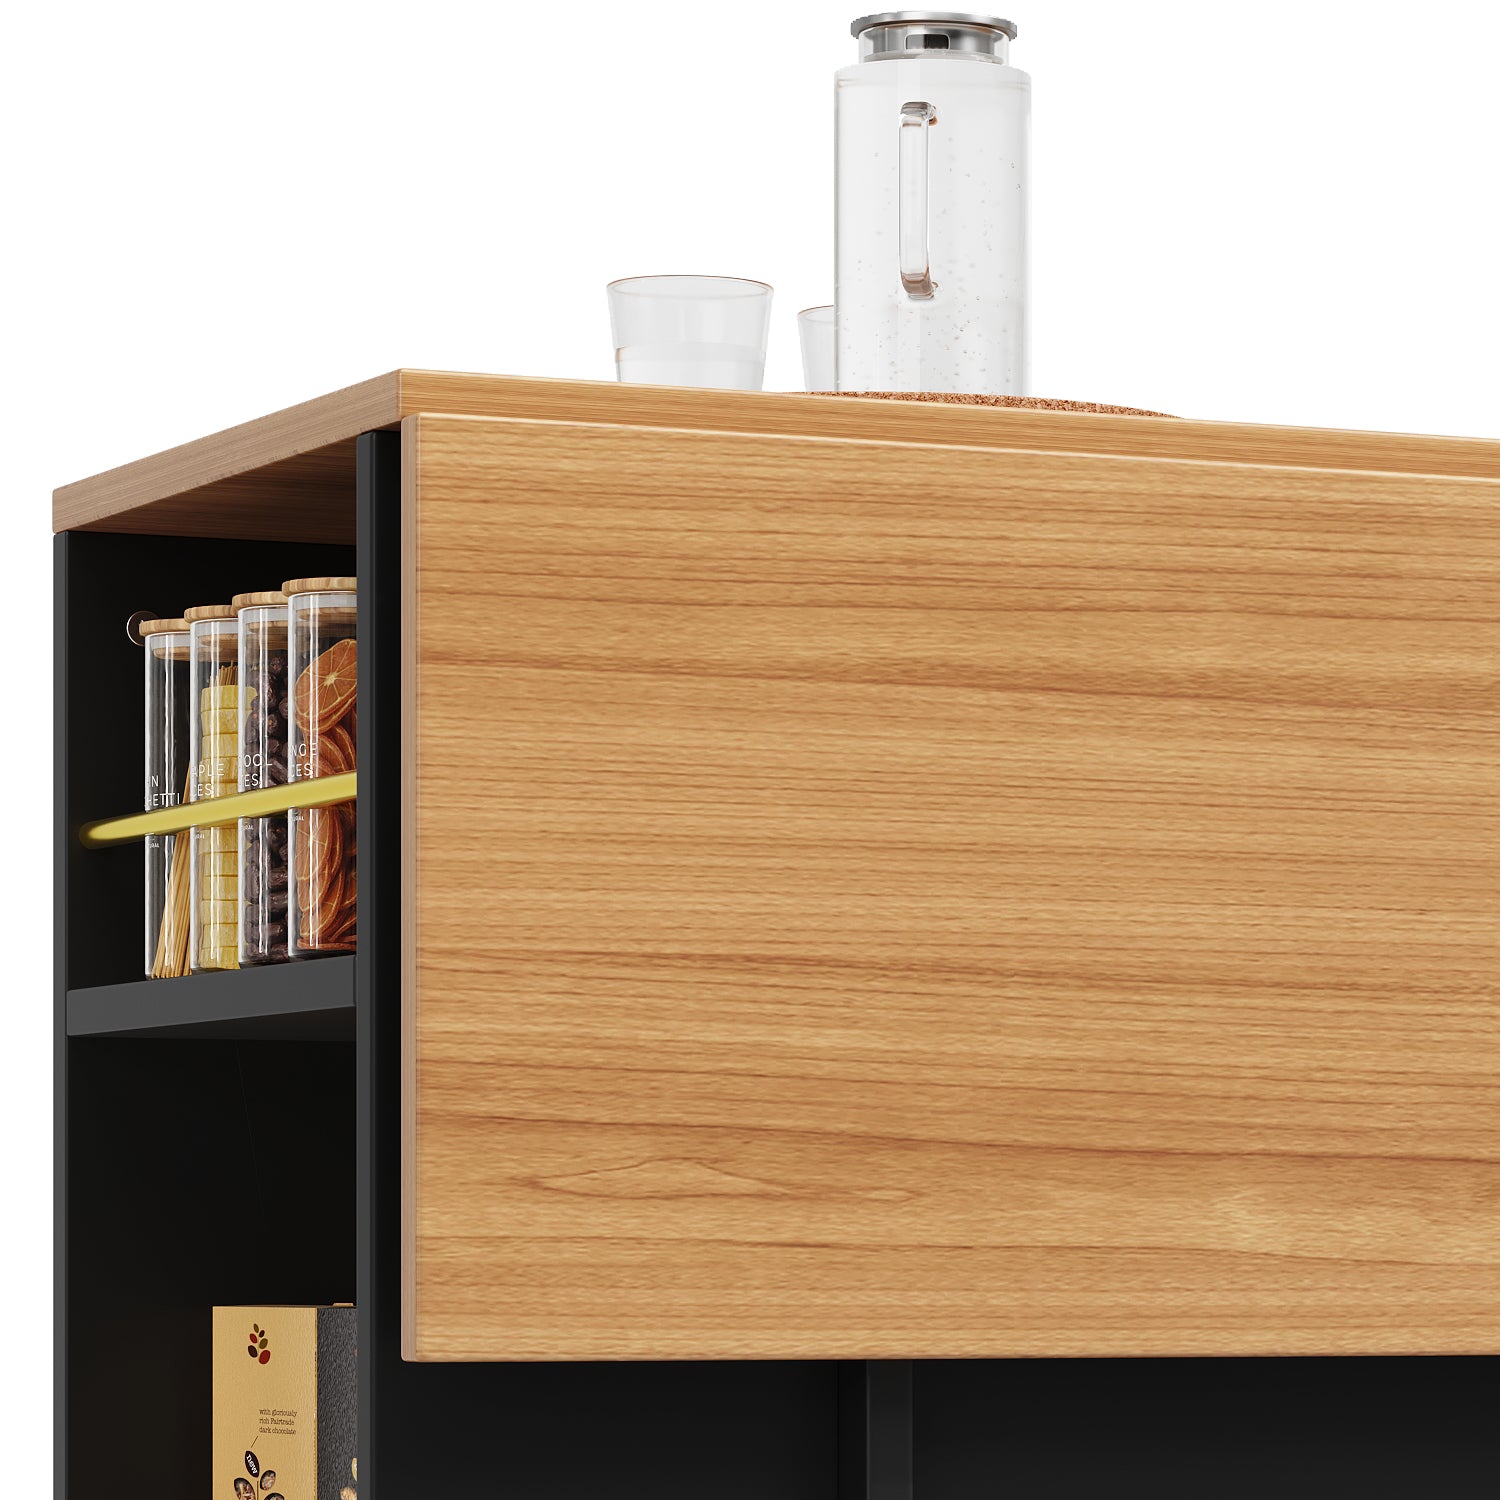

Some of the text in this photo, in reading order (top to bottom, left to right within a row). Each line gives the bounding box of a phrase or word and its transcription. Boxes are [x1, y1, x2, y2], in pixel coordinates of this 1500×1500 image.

[272, 1409, 298, 1418] gloriously
[270, 1418, 295, 1426] Fairtrade
[259, 1426, 297, 1435] dark chocolate
[246, 1454, 258, 1474] new
